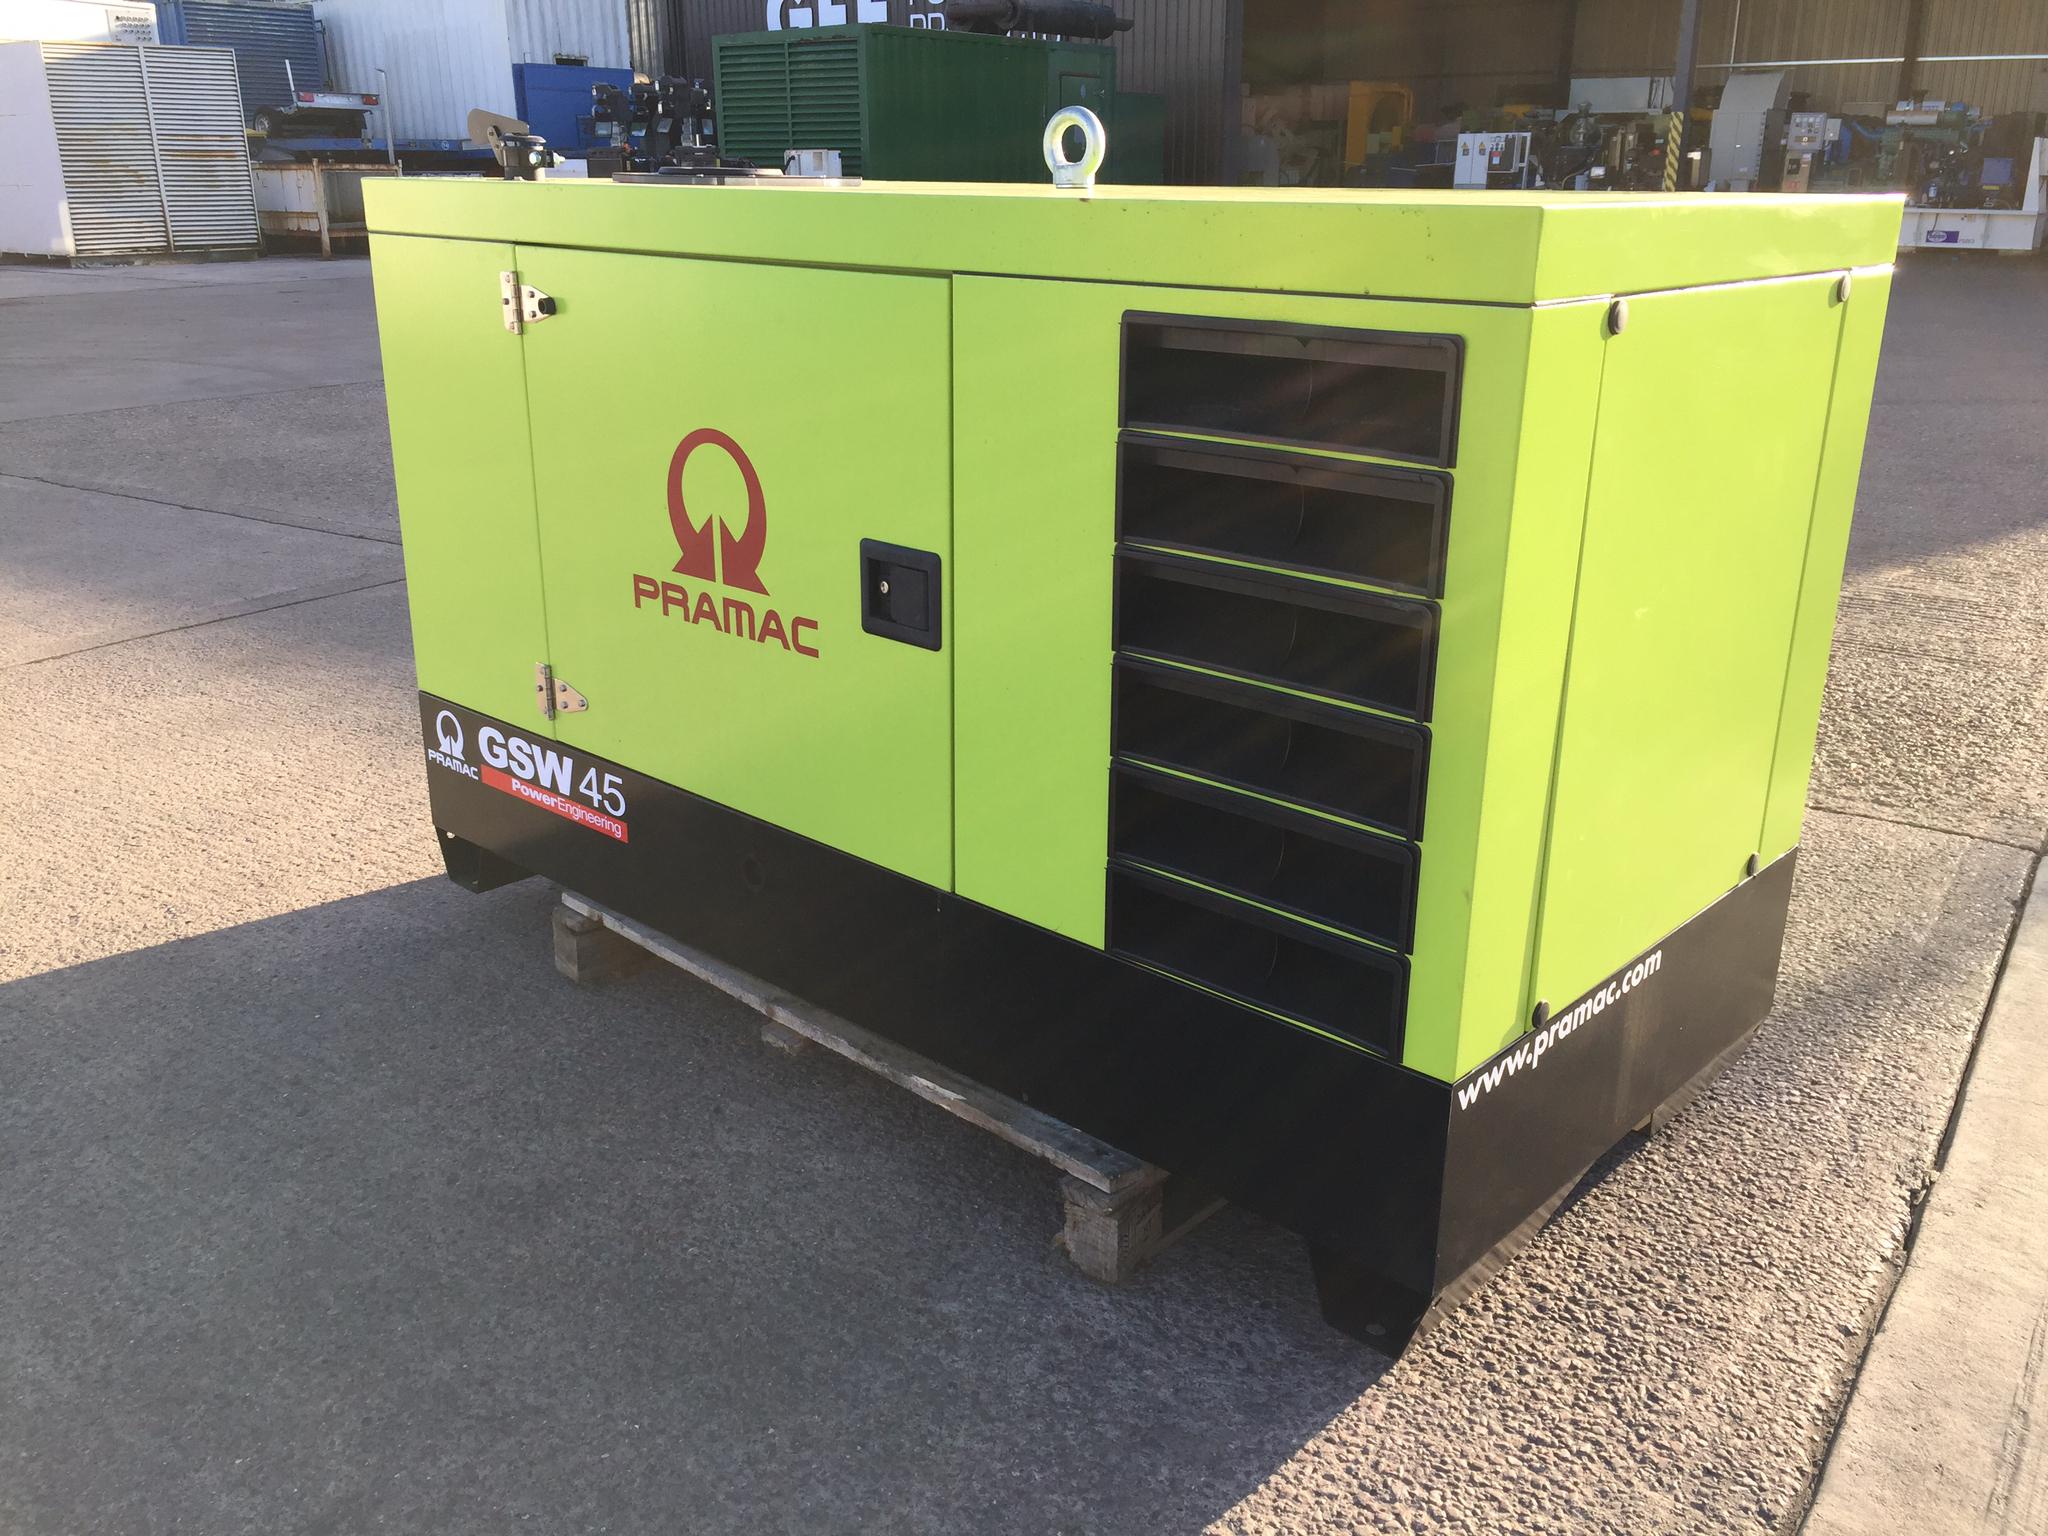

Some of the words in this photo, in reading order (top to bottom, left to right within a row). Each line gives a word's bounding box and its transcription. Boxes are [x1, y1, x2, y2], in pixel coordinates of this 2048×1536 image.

[633, 573, 820, 659] PRAMAC
[428, 748, 479, 781] PRAMAC
[478, 726, 574, 796] GSW
[579, 767, 626, 817] 45
[511, 778, 622, 838] PowerEngineering
[1457, 949, 1663, 1111] www.pramac.com
